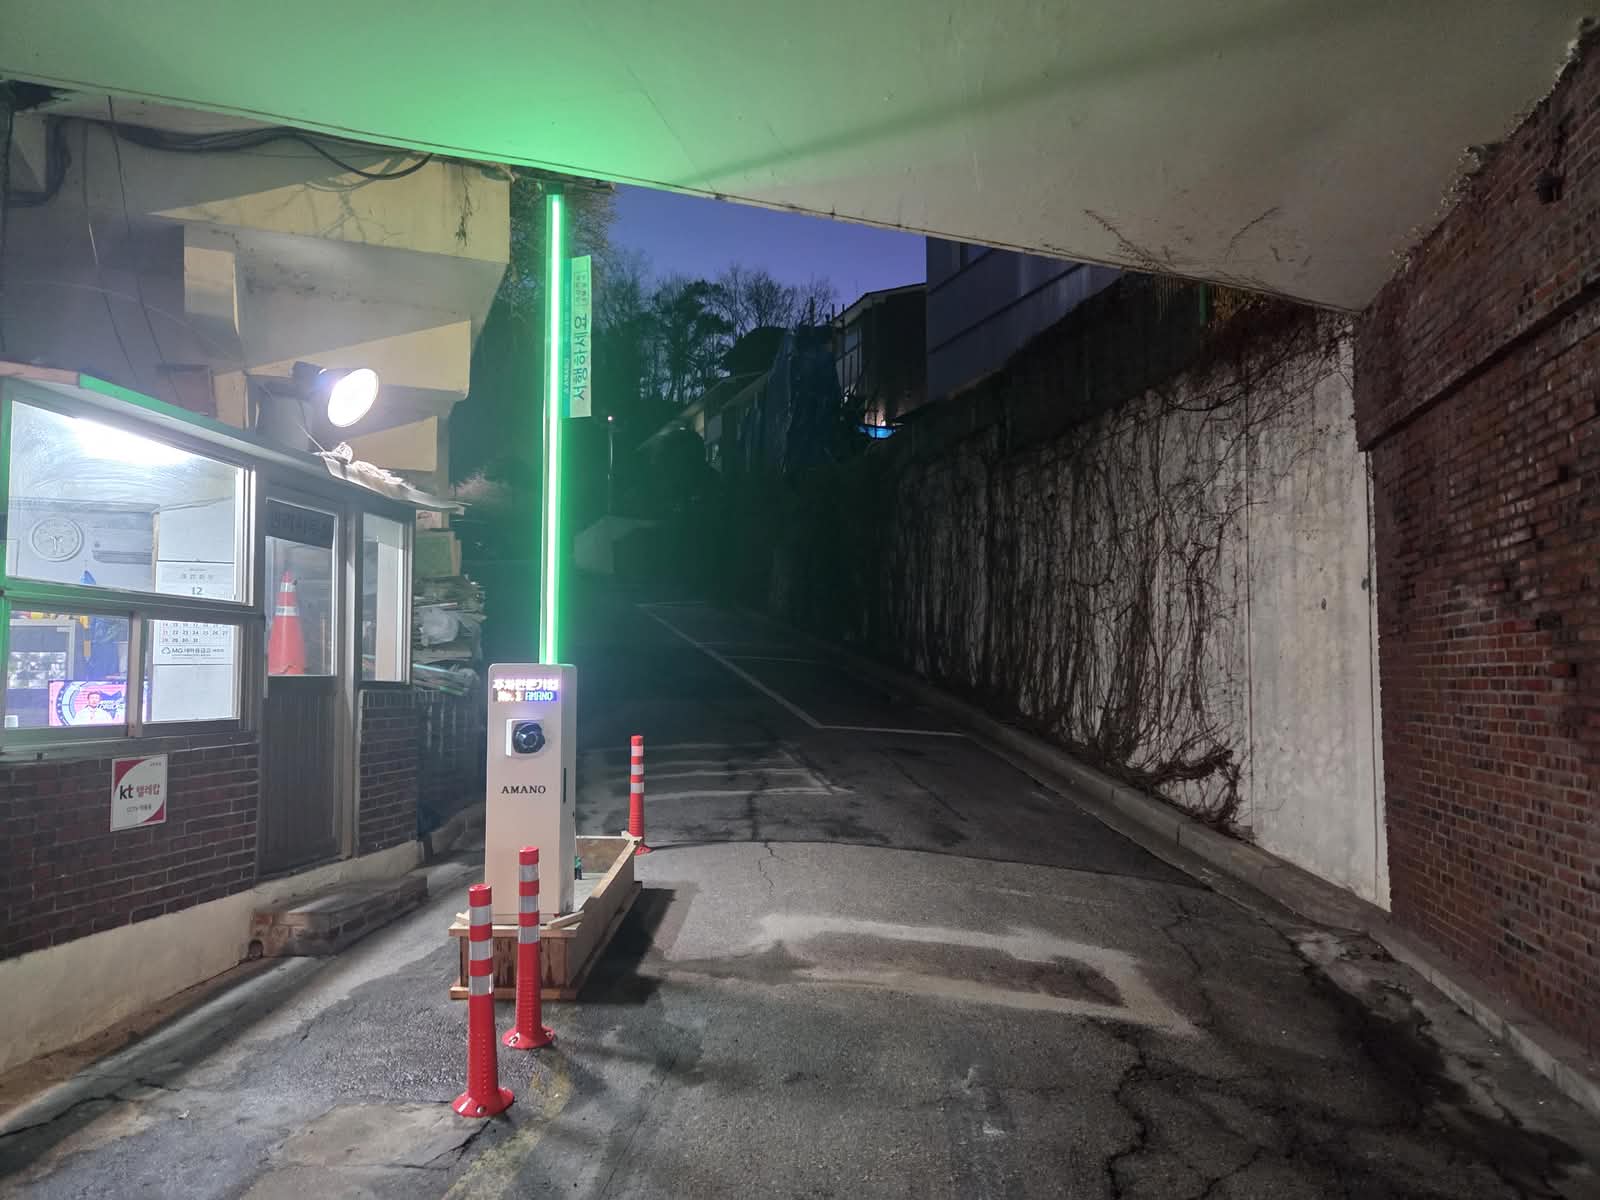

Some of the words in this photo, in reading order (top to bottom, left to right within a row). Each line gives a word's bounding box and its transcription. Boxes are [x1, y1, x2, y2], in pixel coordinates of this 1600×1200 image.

[574, 313, 589, 401] 서행하세요
[192, 587, 203, 595] 12
[526, 691, 554, 701] AMANO
[120, 784, 134, 800] kt
[501, 785, 547, 794] AMANO
